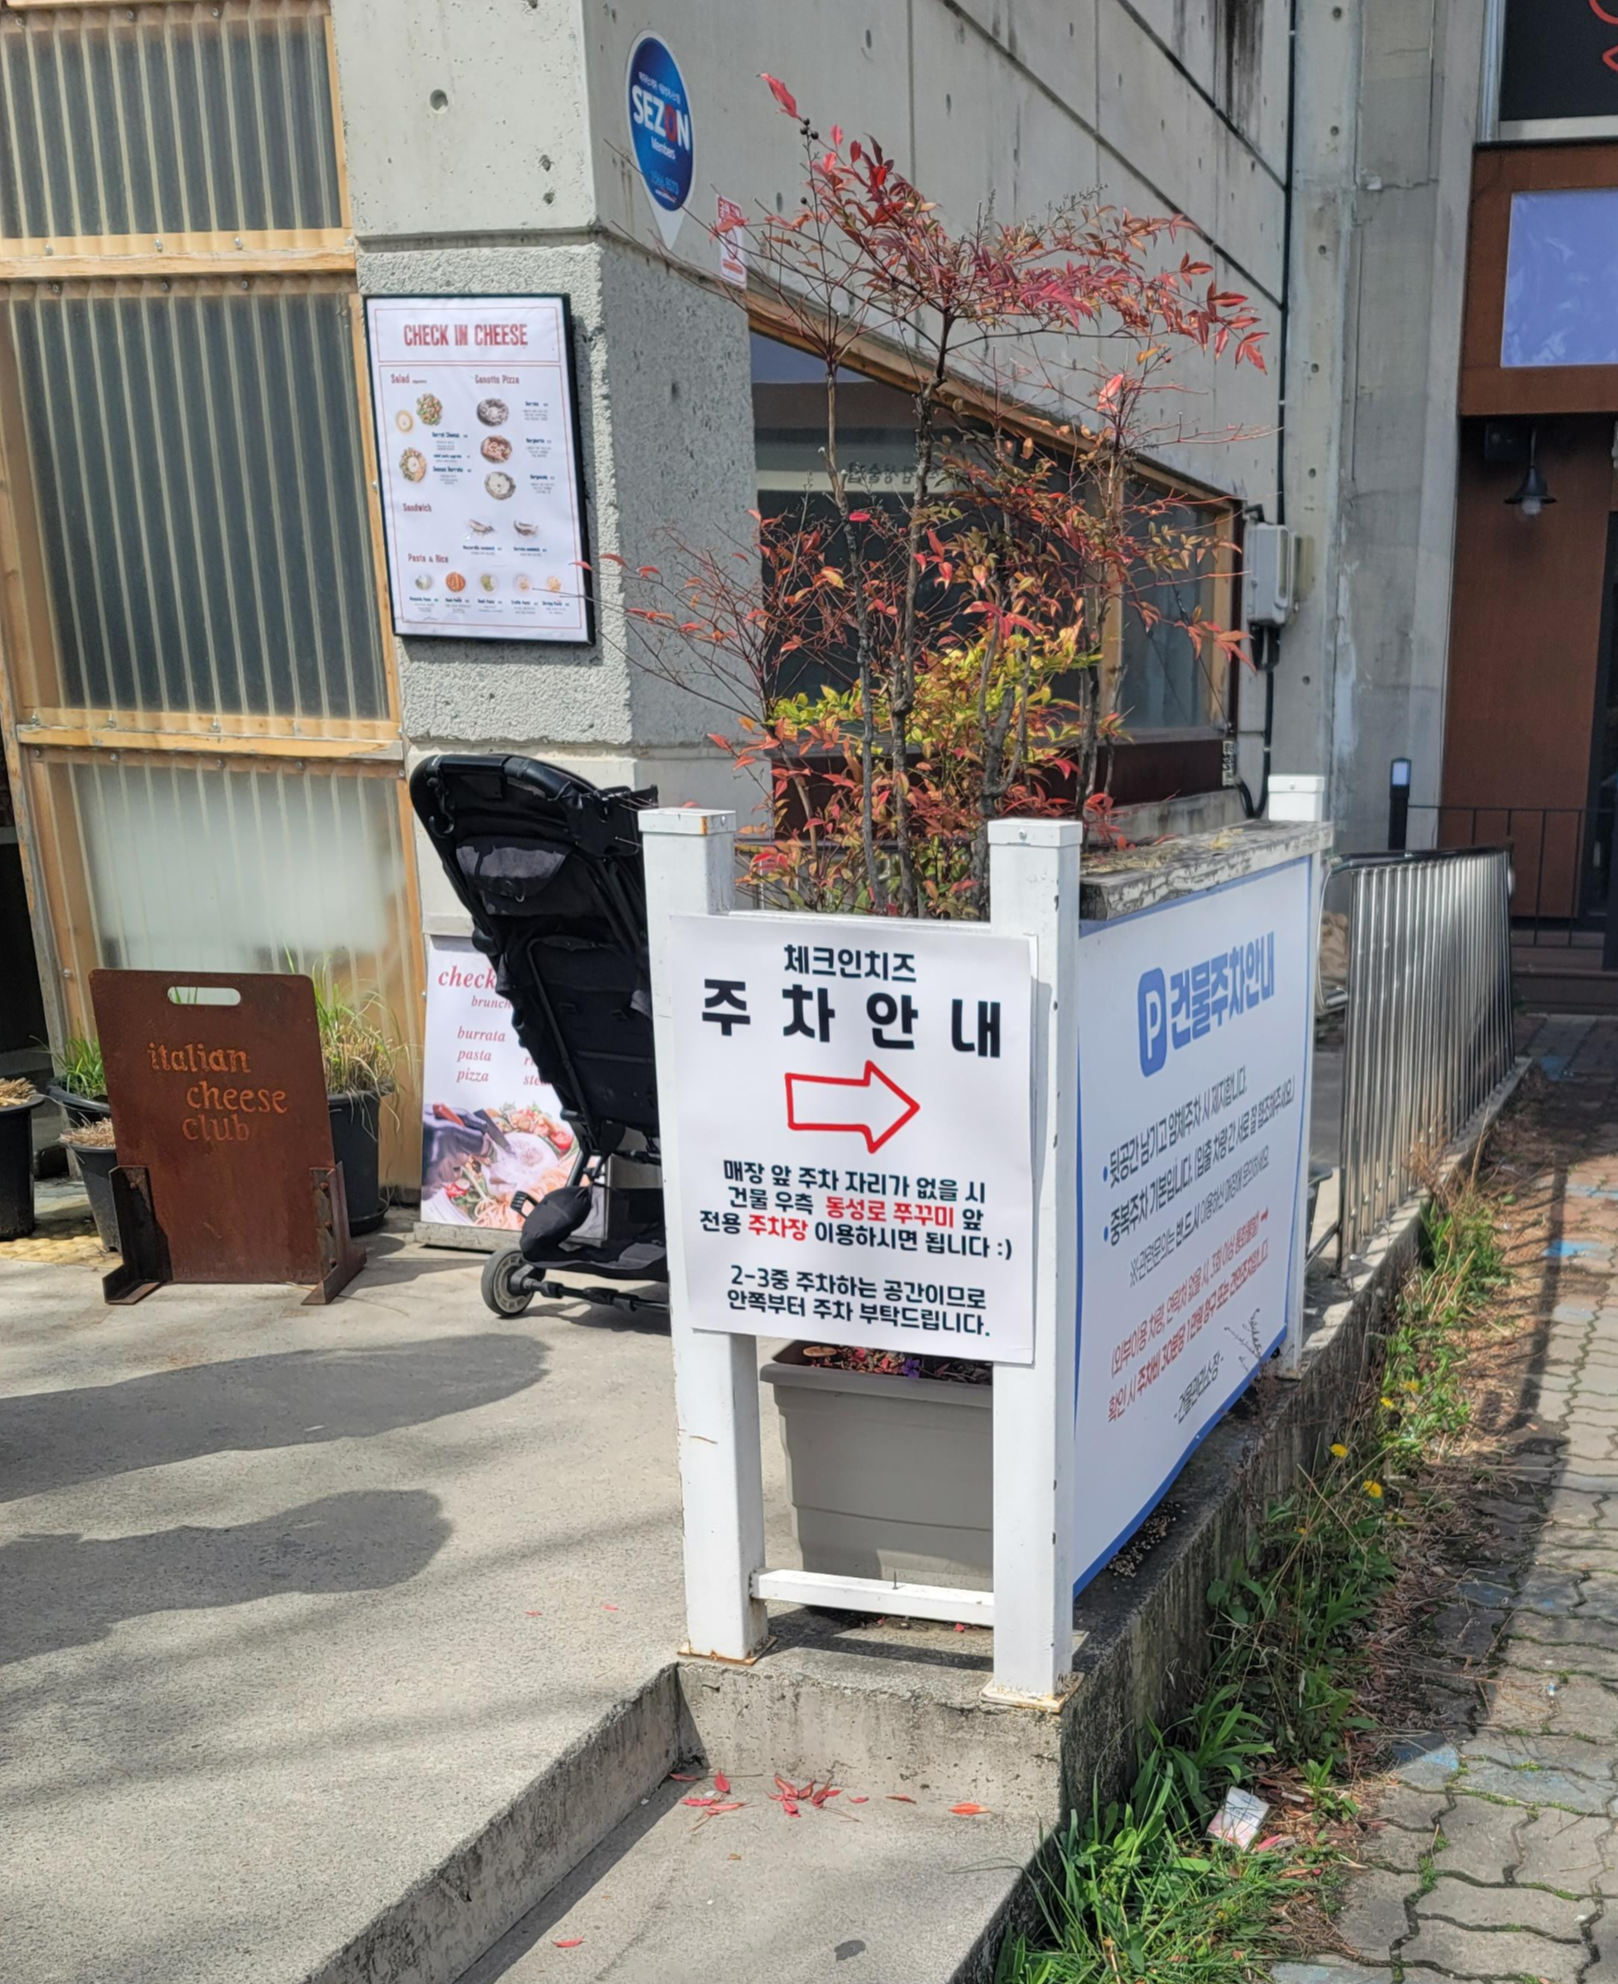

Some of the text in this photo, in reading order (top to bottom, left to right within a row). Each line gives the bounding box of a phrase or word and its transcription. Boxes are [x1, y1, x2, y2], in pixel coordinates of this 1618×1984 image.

[632, 84, 690, 151] SEZON
[403, 324, 528, 347] CHECK IN CHEESE
[391, 374, 410, 384] Salad
[502, 375, 520, 384] Pizza
[403, 503, 432, 512] Sandwich
[408, 554, 427, 562] Pasta
[436, 555, 449, 563] Rice
[438, 966, 496, 989] check
[784, 945, 916, 982] 체크인치즈
[471, 995, 511, 1010] brunch
[1170, 931, 1274, 1050] 건물주차안내
[457, 1026, 506, 1042] burrata
[148, 1042, 251, 1073] italian
[457, 1050, 492, 1062] pasta
[456, 1067, 489, 1082] pizza
[186, 1080, 288, 1114] cheese
[182, 1113, 249, 1141] club
[1110, 1134, 1141, 1189] 뒷공간
[1140, 1117, 1169, 1167] 남기고
[1202, 1089, 1212, 1122] 시
[724, 1160, 985, 1203] 매장 앞 주차 자리가 없을 시
[1110, 1185, 1149, 1246] 중복주차
[1236, 1110, 1250, 1145] 서로
[728, 1186, 984, 1231] 건물 우측 동성로 쭈꾸미 앞
[700, 1210, 1012, 1260] 전용 주차장 이용하시면 됩니다 :)
[1176, 1203, 1200, 1248] 반드시
[731, 1265, 986, 1310] 2-3중 주차하는 공간이므로
[727, 1290, 990, 1336] 안쪽부터 주차 부탁드립니다.
